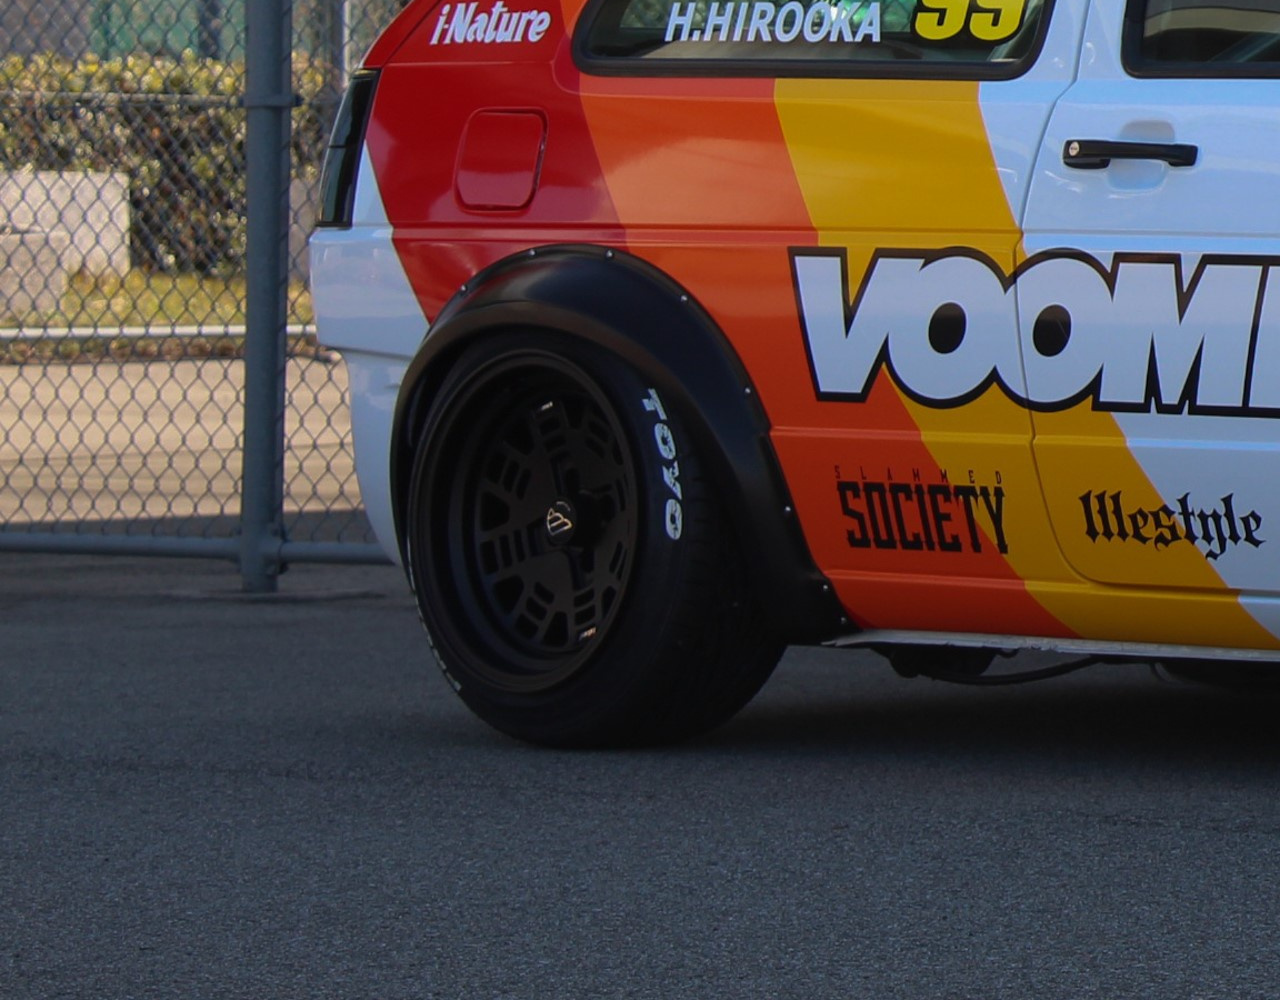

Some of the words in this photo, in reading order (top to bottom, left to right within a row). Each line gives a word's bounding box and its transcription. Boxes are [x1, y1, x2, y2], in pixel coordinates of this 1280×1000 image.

[430, 0, 550, 45] i-Nature
[665, 1, 881, 42] H.HIROOKA
[642, 388, 682, 541] TOYO
[837, 481, 1008, 554] SOCIETY
